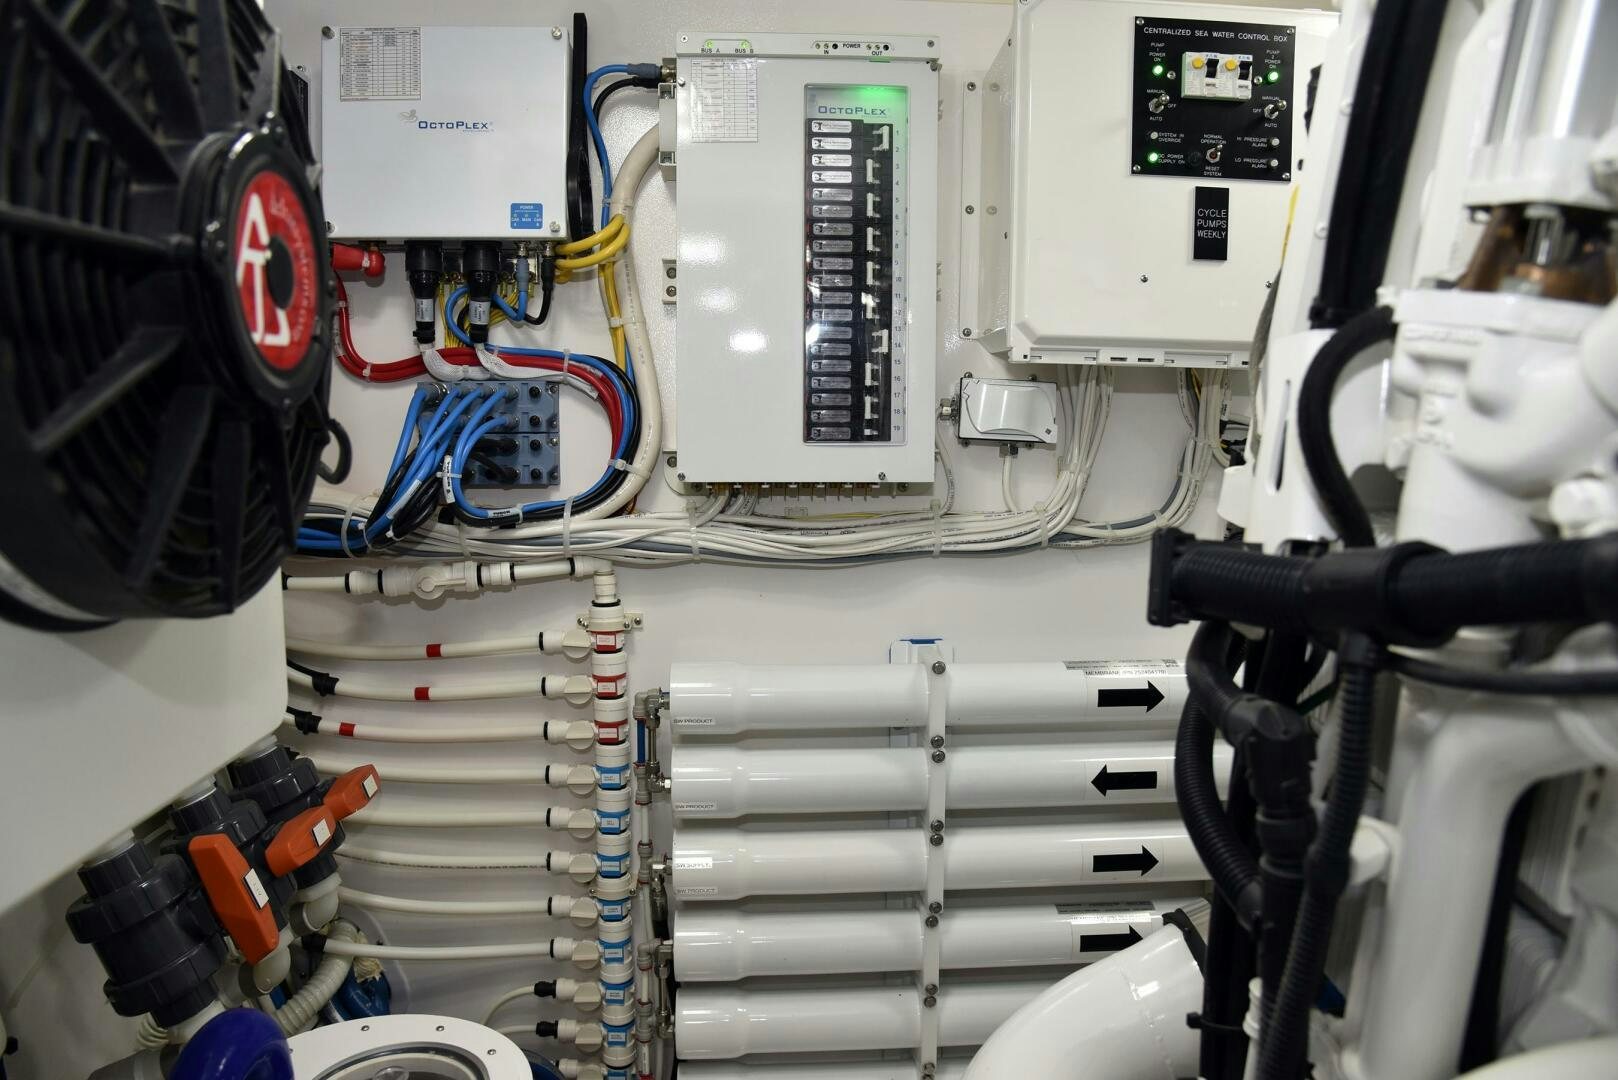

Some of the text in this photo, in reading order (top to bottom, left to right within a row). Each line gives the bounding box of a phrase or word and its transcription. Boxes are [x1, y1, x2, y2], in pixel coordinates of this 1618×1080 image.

[1144, 26, 1191, 36] CENTRALIZED
[1238, 32, 1270, 41] CONTROL
[1198, 208, 1227, 218] CYCLE
[1197, 218, 1227, 228] PUMPS
[1197, 230, 1226, 238] WEEKLY
